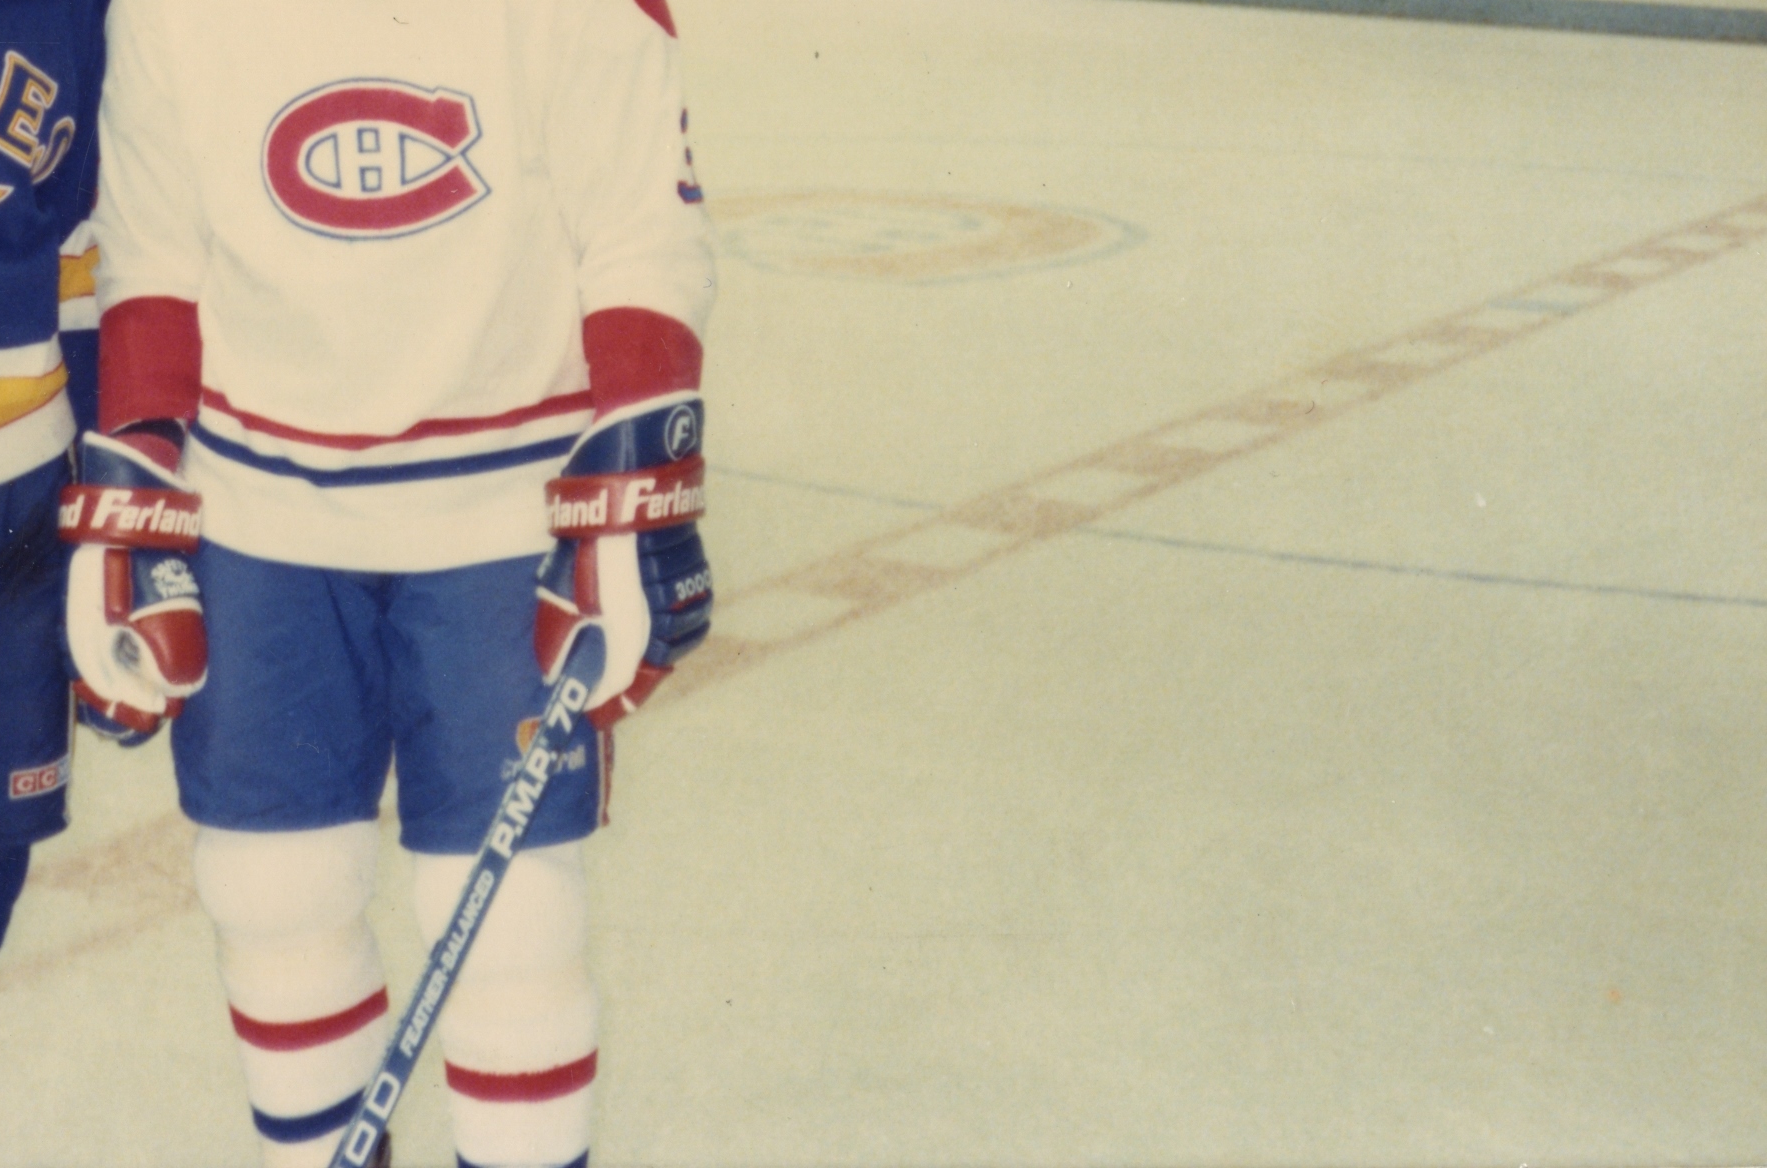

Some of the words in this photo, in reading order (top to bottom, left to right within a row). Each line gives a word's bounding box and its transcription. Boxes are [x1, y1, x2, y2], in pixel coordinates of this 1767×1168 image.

[671, 415, 692, 451] F
[90, 489, 202, 538] Ferland
[621, 477, 705, 524] Ferlan
[10, 760, 70, 798] CC
[399, 868, 495, 1059] FEATHER-BALANCED
[547, 677, 588, 734] 70
